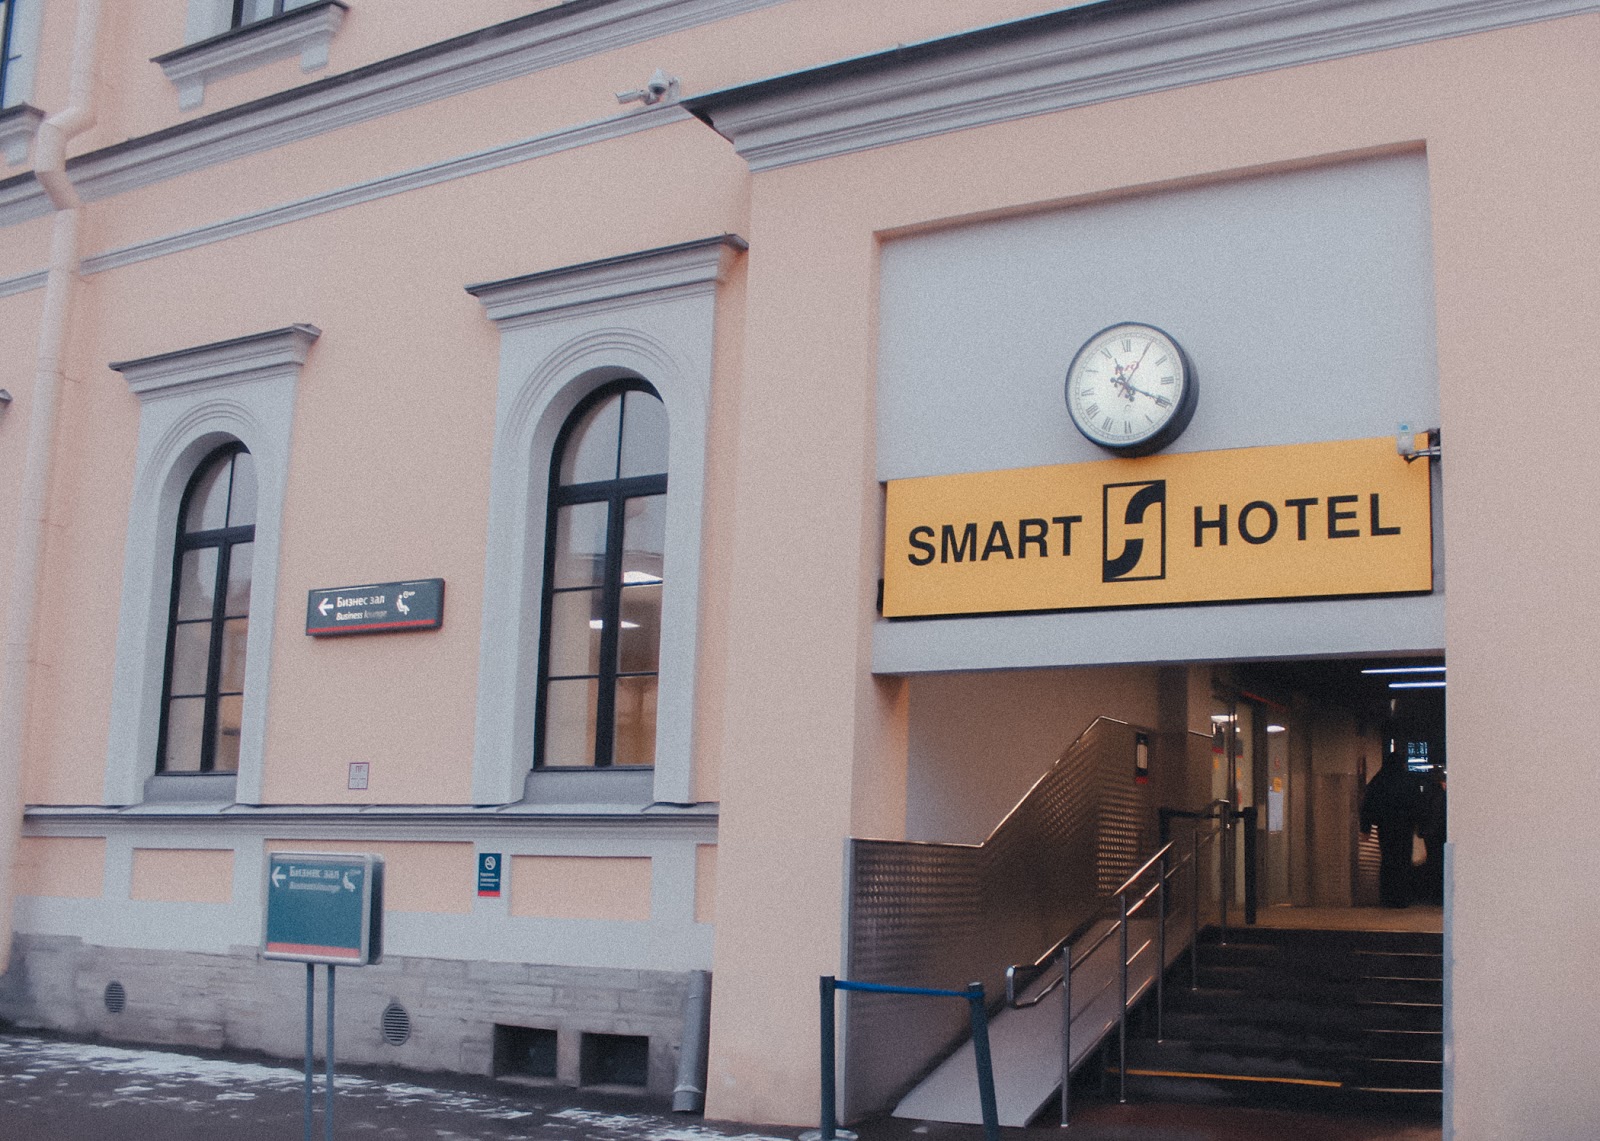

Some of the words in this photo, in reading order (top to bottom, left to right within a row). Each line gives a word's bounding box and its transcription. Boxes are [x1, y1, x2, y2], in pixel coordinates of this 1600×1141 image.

[908, 515, 1082, 566] SMART
[1194, 493, 1401, 547] HOTEL
[337, 596, 368, 607] Бизнес
[369, 595, 385, 604] зал
[336, 611, 363, 620] Business
